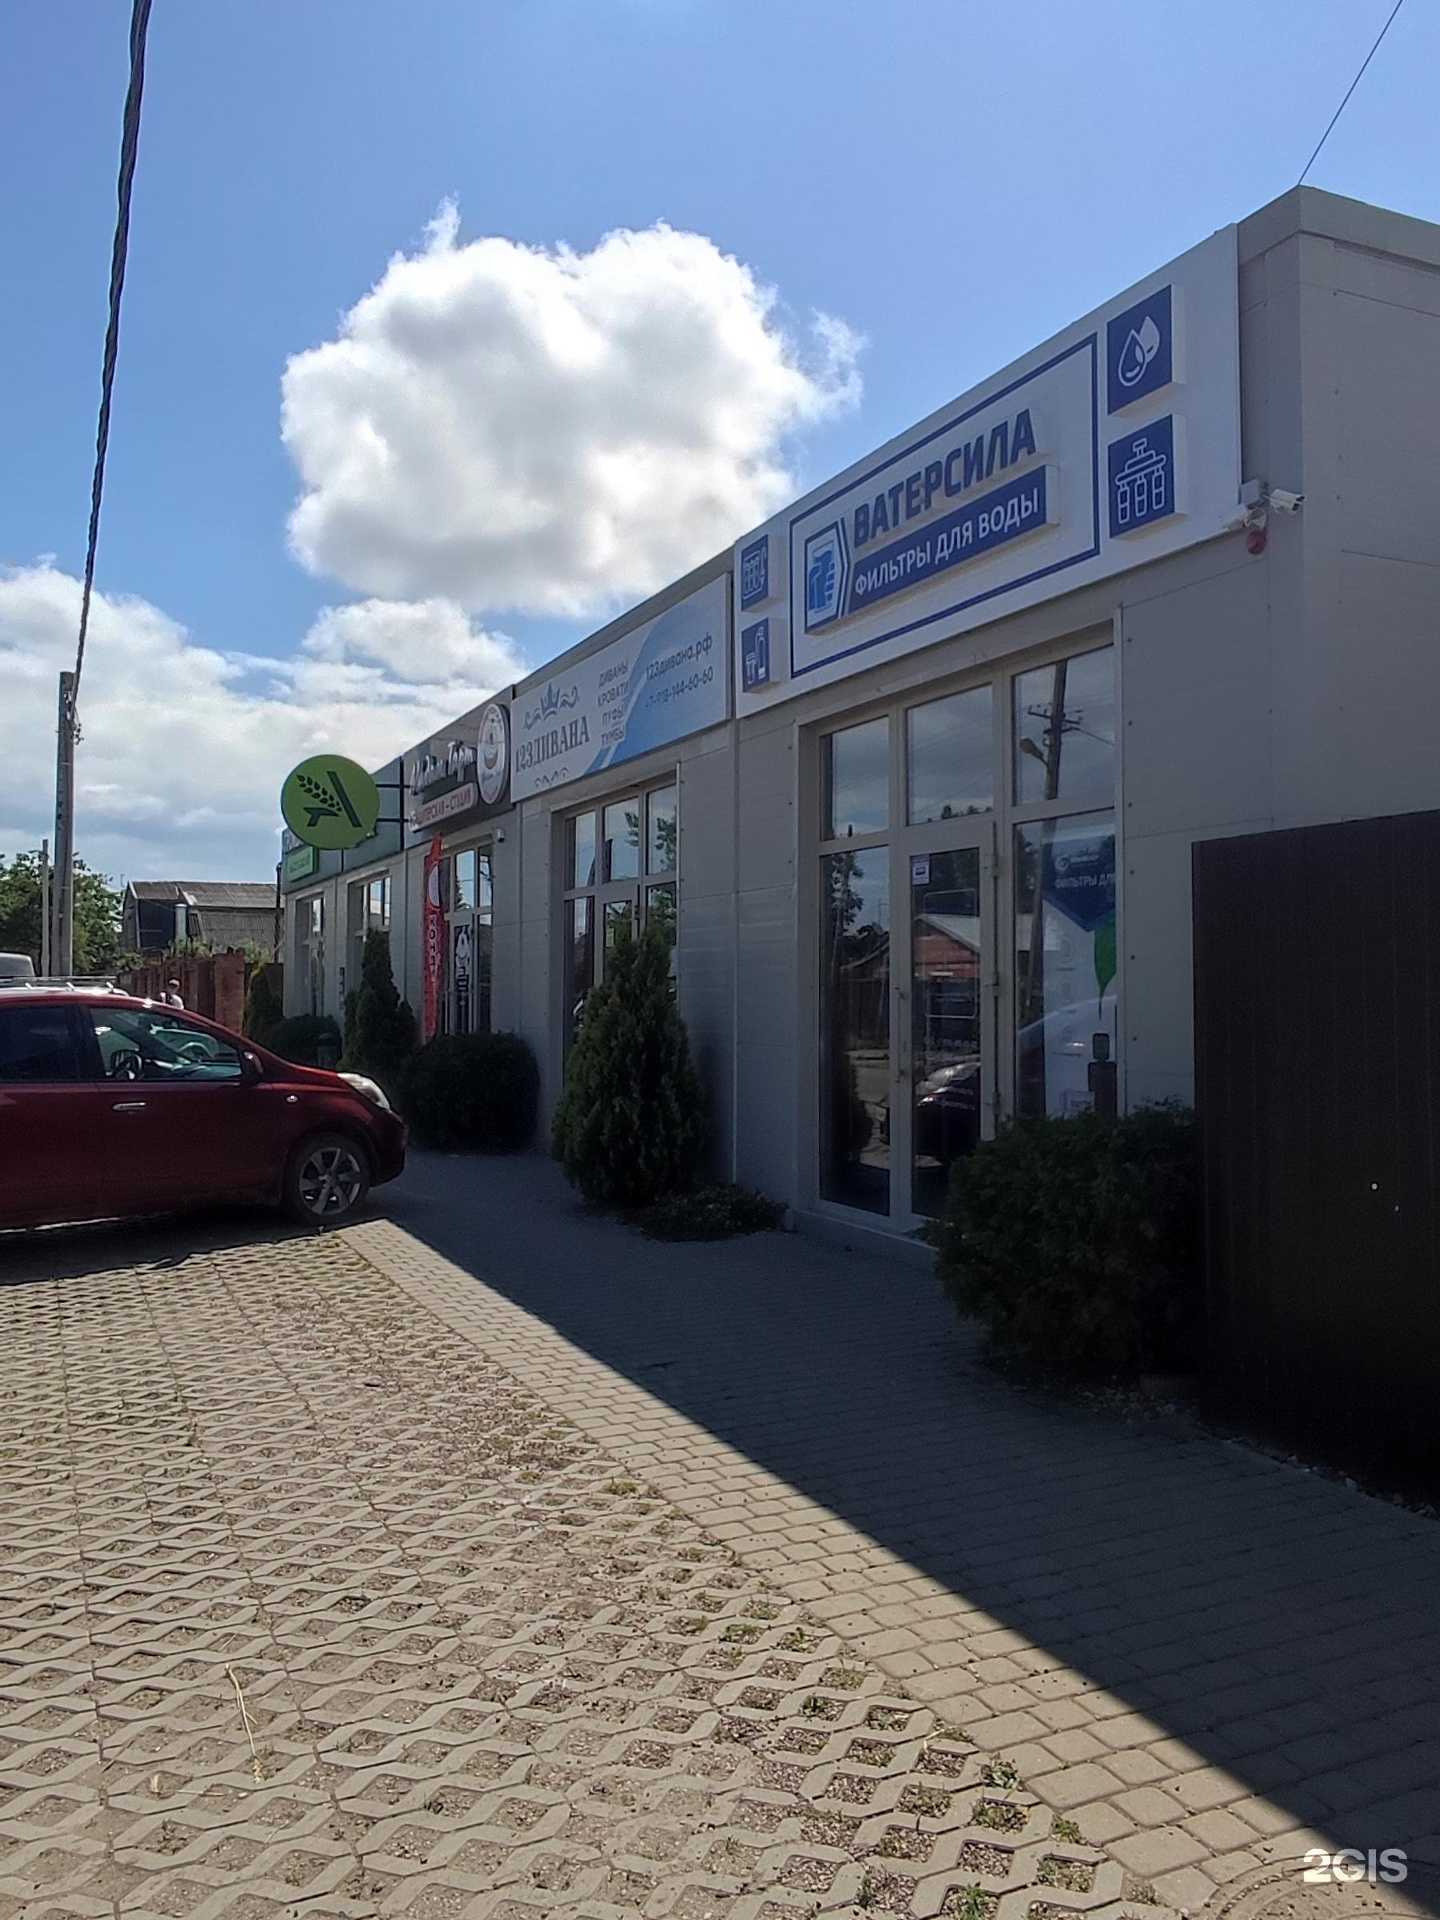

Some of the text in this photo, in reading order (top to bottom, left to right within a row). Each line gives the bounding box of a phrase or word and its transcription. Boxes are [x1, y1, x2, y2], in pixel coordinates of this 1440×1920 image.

[854, 408, 1037, 549] ВАТЕРСИЛА
[855, 487, 1039, 597] ФИЛЬТРЫ ДЛЯ ВОДЫ
